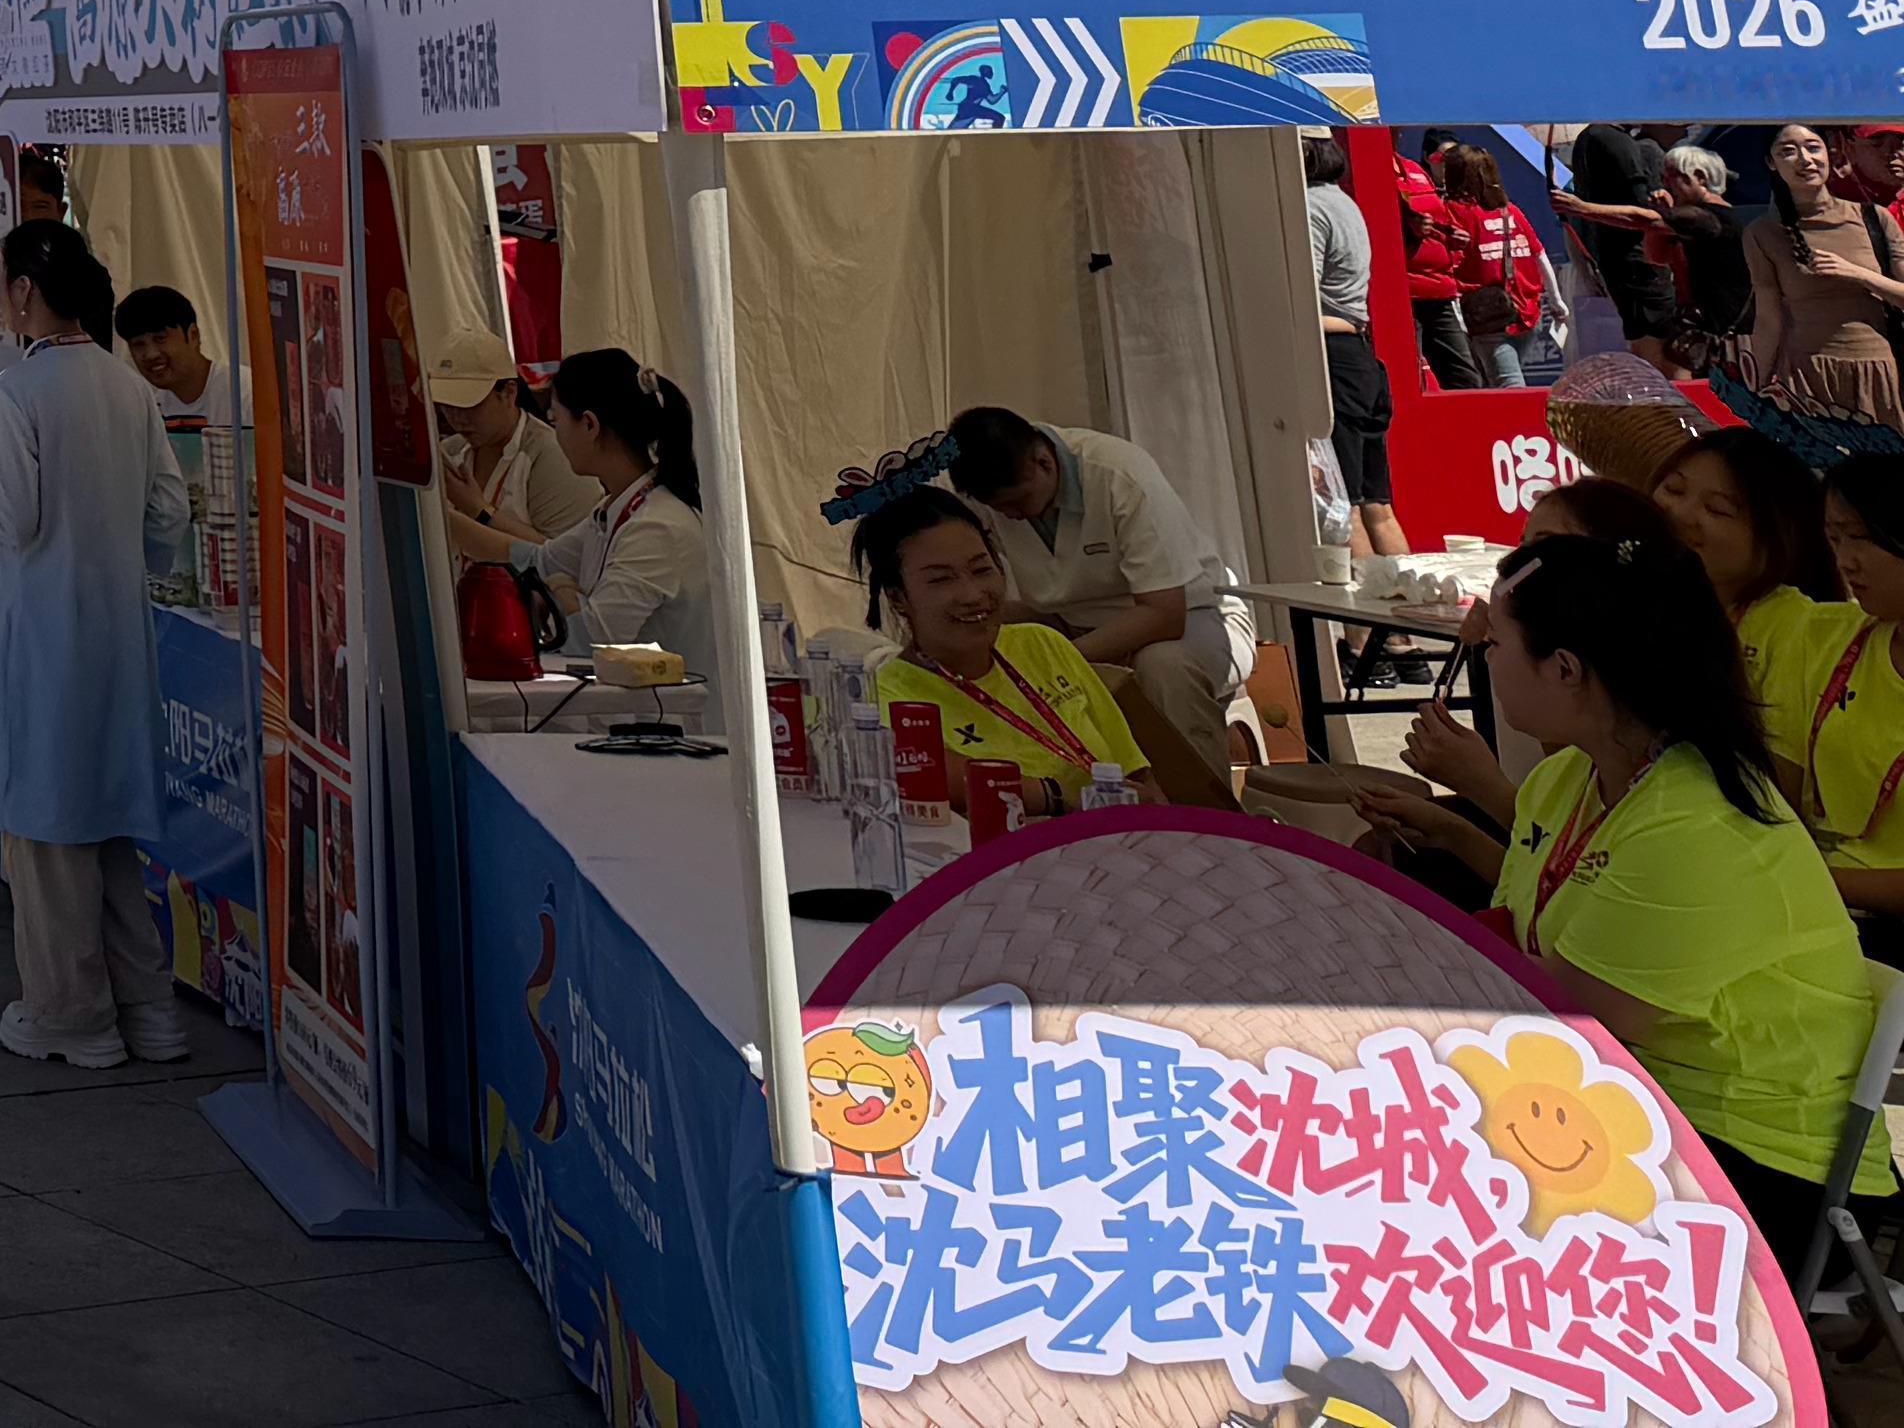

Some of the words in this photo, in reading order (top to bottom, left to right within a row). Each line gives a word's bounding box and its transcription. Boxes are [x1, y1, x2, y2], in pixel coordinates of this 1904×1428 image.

[161, 695, 249, 789] 阳马拉
[205, 795, 250, 839] MARATHO
